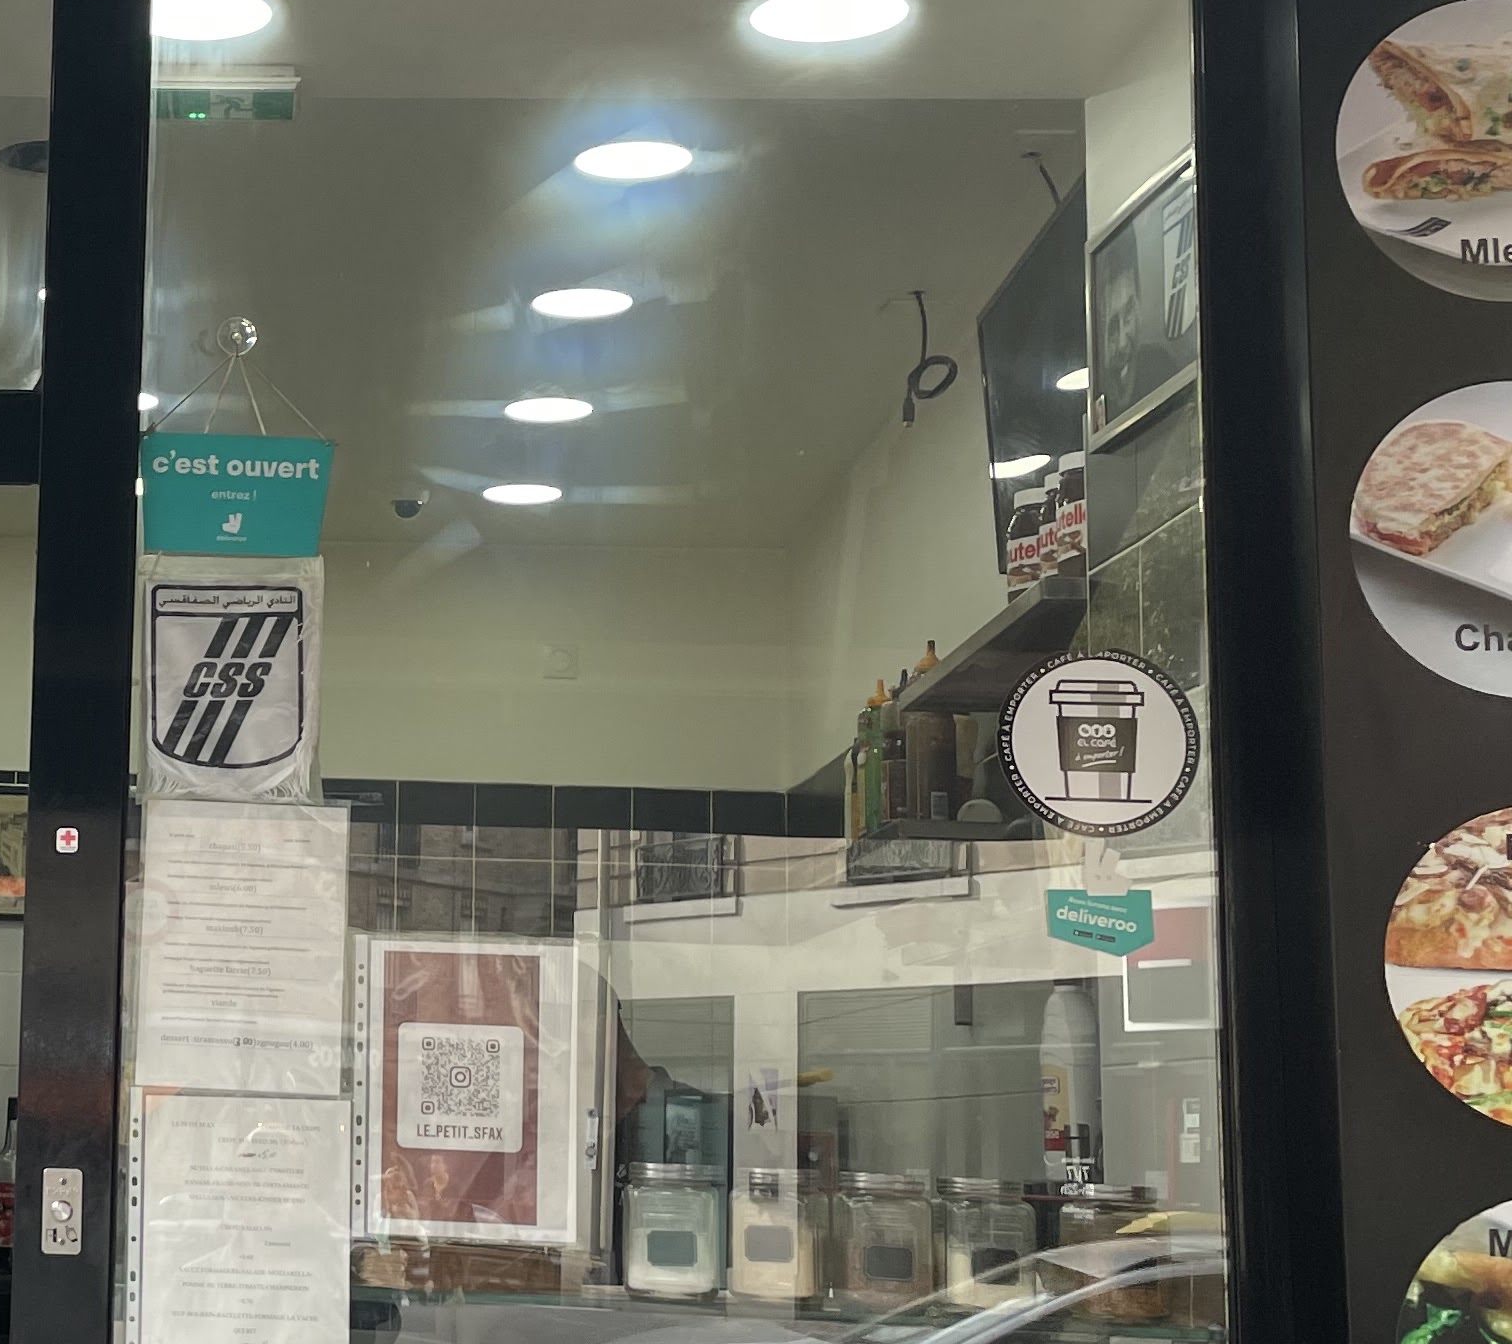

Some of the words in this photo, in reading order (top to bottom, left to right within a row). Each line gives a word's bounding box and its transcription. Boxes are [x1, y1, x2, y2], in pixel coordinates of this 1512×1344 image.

[152, 449, 220, 476] c'est
[226, 458, 321, 480] ouvert
[211, 490, 250, 501] entrez
[222, 594, 264, 610] الرياضي
[266, 594, 297, 609] النادي
[1455, 623, 1512, 652] Ch
[182, 661, 273, 698] CSS
[1055, 904, 1138, 934] deliveroo
